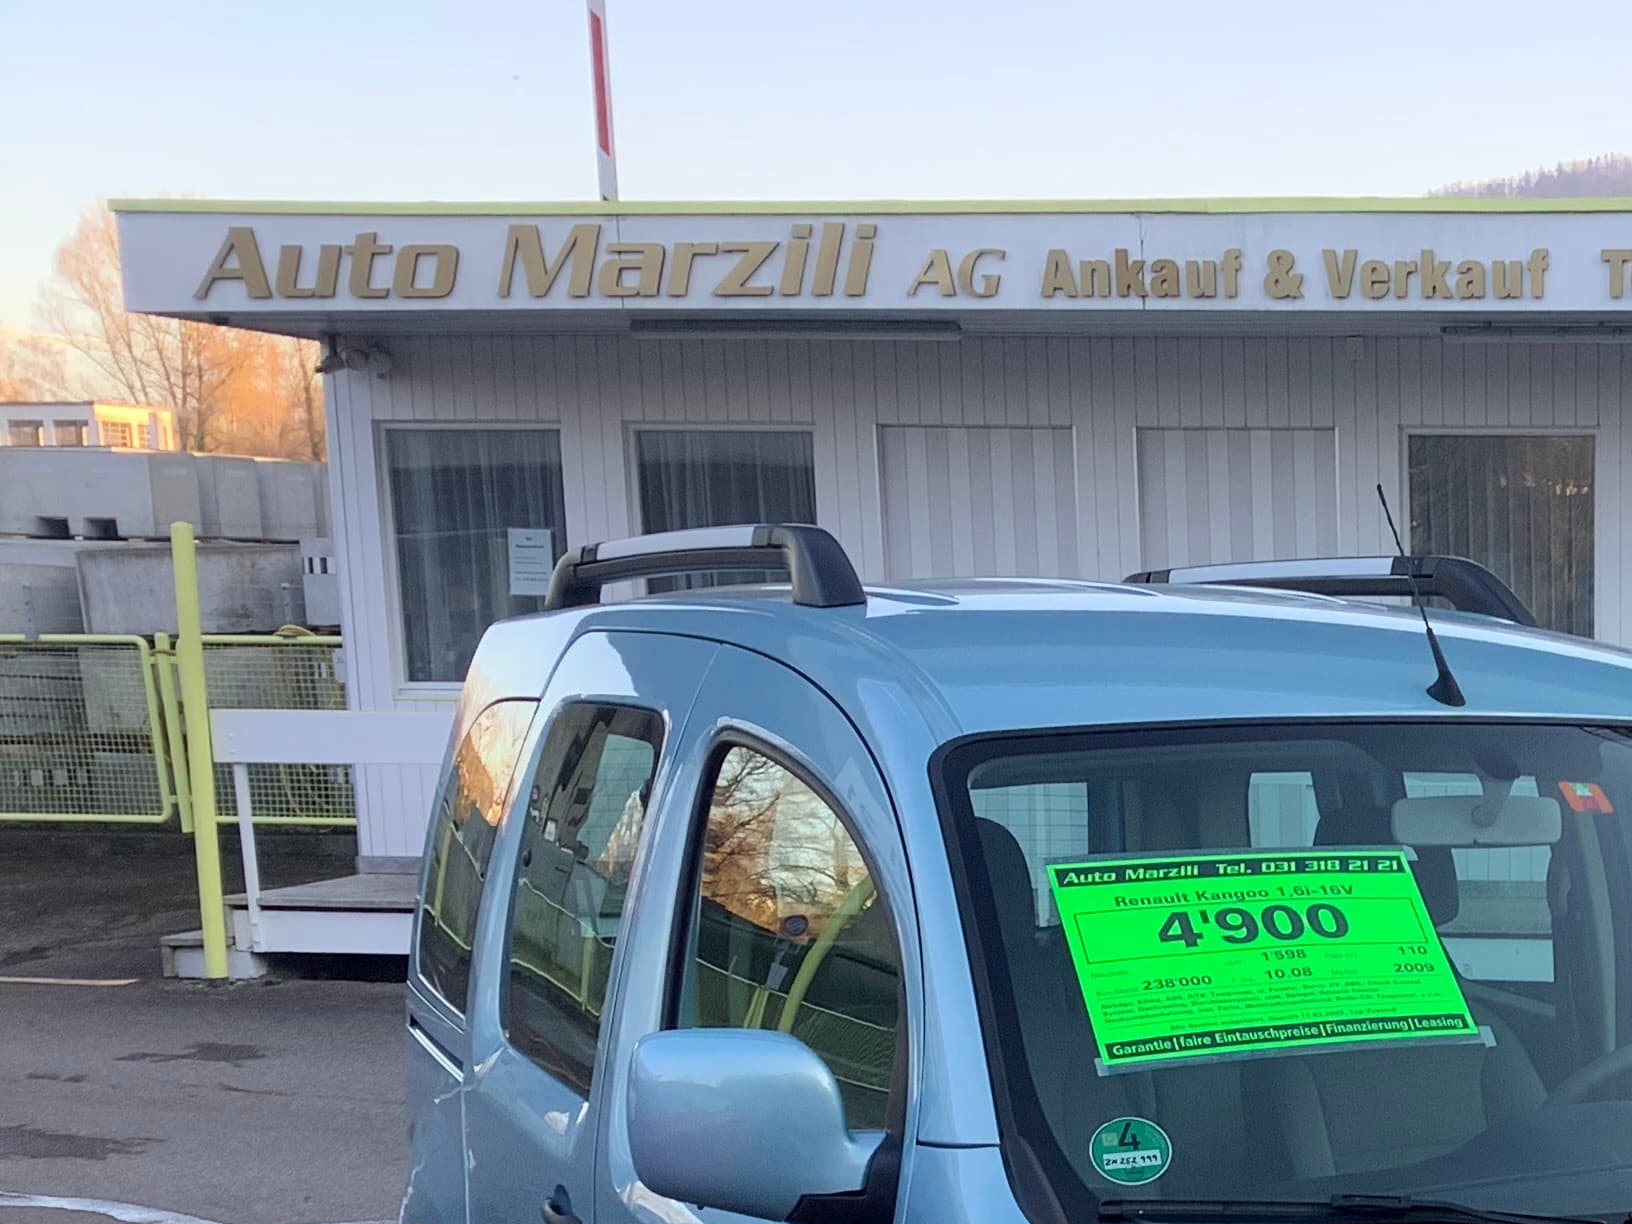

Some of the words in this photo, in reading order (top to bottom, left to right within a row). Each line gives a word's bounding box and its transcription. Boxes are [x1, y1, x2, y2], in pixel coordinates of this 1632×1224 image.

[194, 226, 460, 300] Auto
[497, 222, 877, 300] Marzili
[906, 248, 1006, 298] AG
[1041, 247, 1242, 300] Ankauf
[1263, 248, 1306, 300] &
[1322, 247, 1549, 300] Verkauf
[1063, 871, 1116, 885] Auto
[1125, 865, 1199, 880] Marzili
[1216, 863, 1252, 875] Tel.
[1261, 861, 1296, 872] 031
[1305, 860, 1340, 872] 318
[1348, 859, 1369, 871] 21
[1378, 859, 1398, 871] 21
[1114, 892, 1190, 907] Renault
[1195, 888, 1269, 902] Kangoo
[1158, 903, 1349, 948] 4'900
[1397, 945, 1428, 956] 110
[1141, 975, 1212, 991] 238'000
[1393, 962, 1435, 973] 2009
[1119, 1122, 1141, 1151] 4
